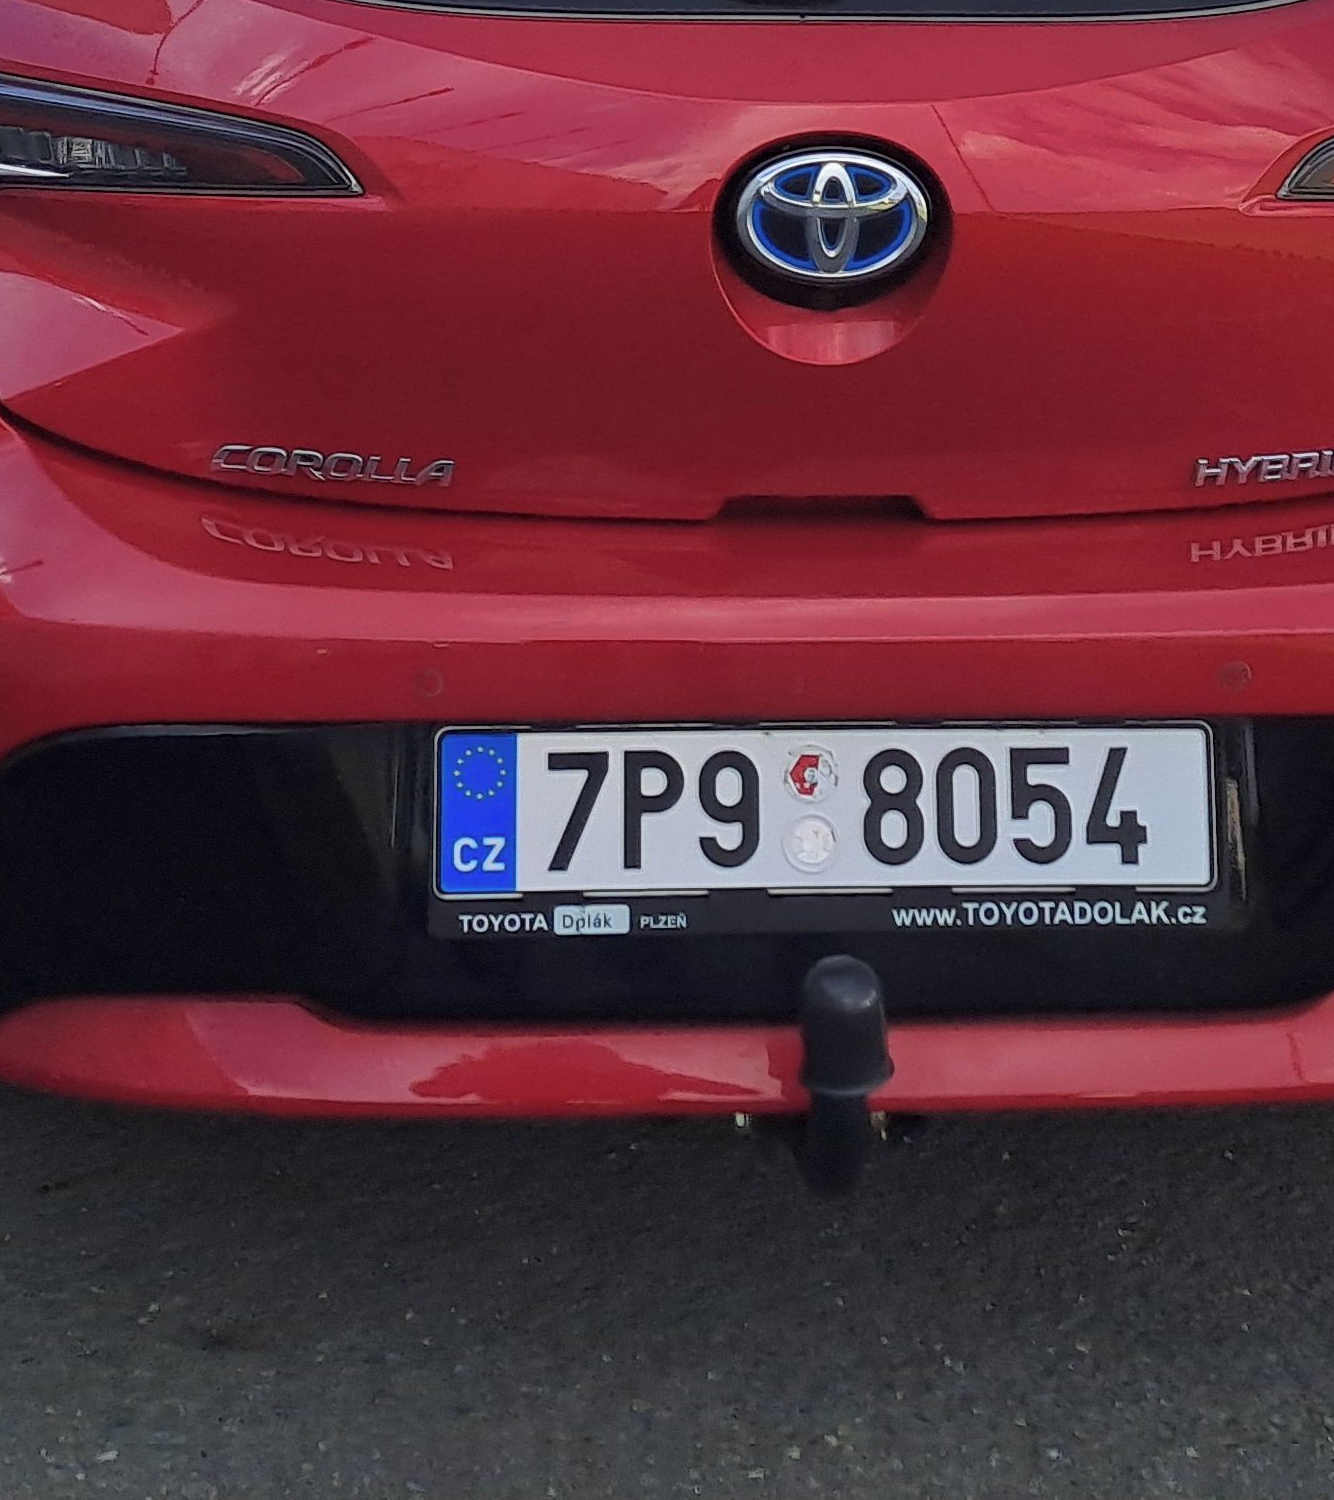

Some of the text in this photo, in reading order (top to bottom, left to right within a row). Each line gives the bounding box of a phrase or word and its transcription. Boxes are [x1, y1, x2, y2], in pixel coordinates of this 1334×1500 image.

[212, 444, 455, 487] COROLLA
[547, 747, 1147, 871] 7P9 8054
[453, 836, 506, 872] CZ
[459, 913, 549, 933] TOYOTA
[892, 901, 1207, 927] www.TOYOTADOLAK.cz
